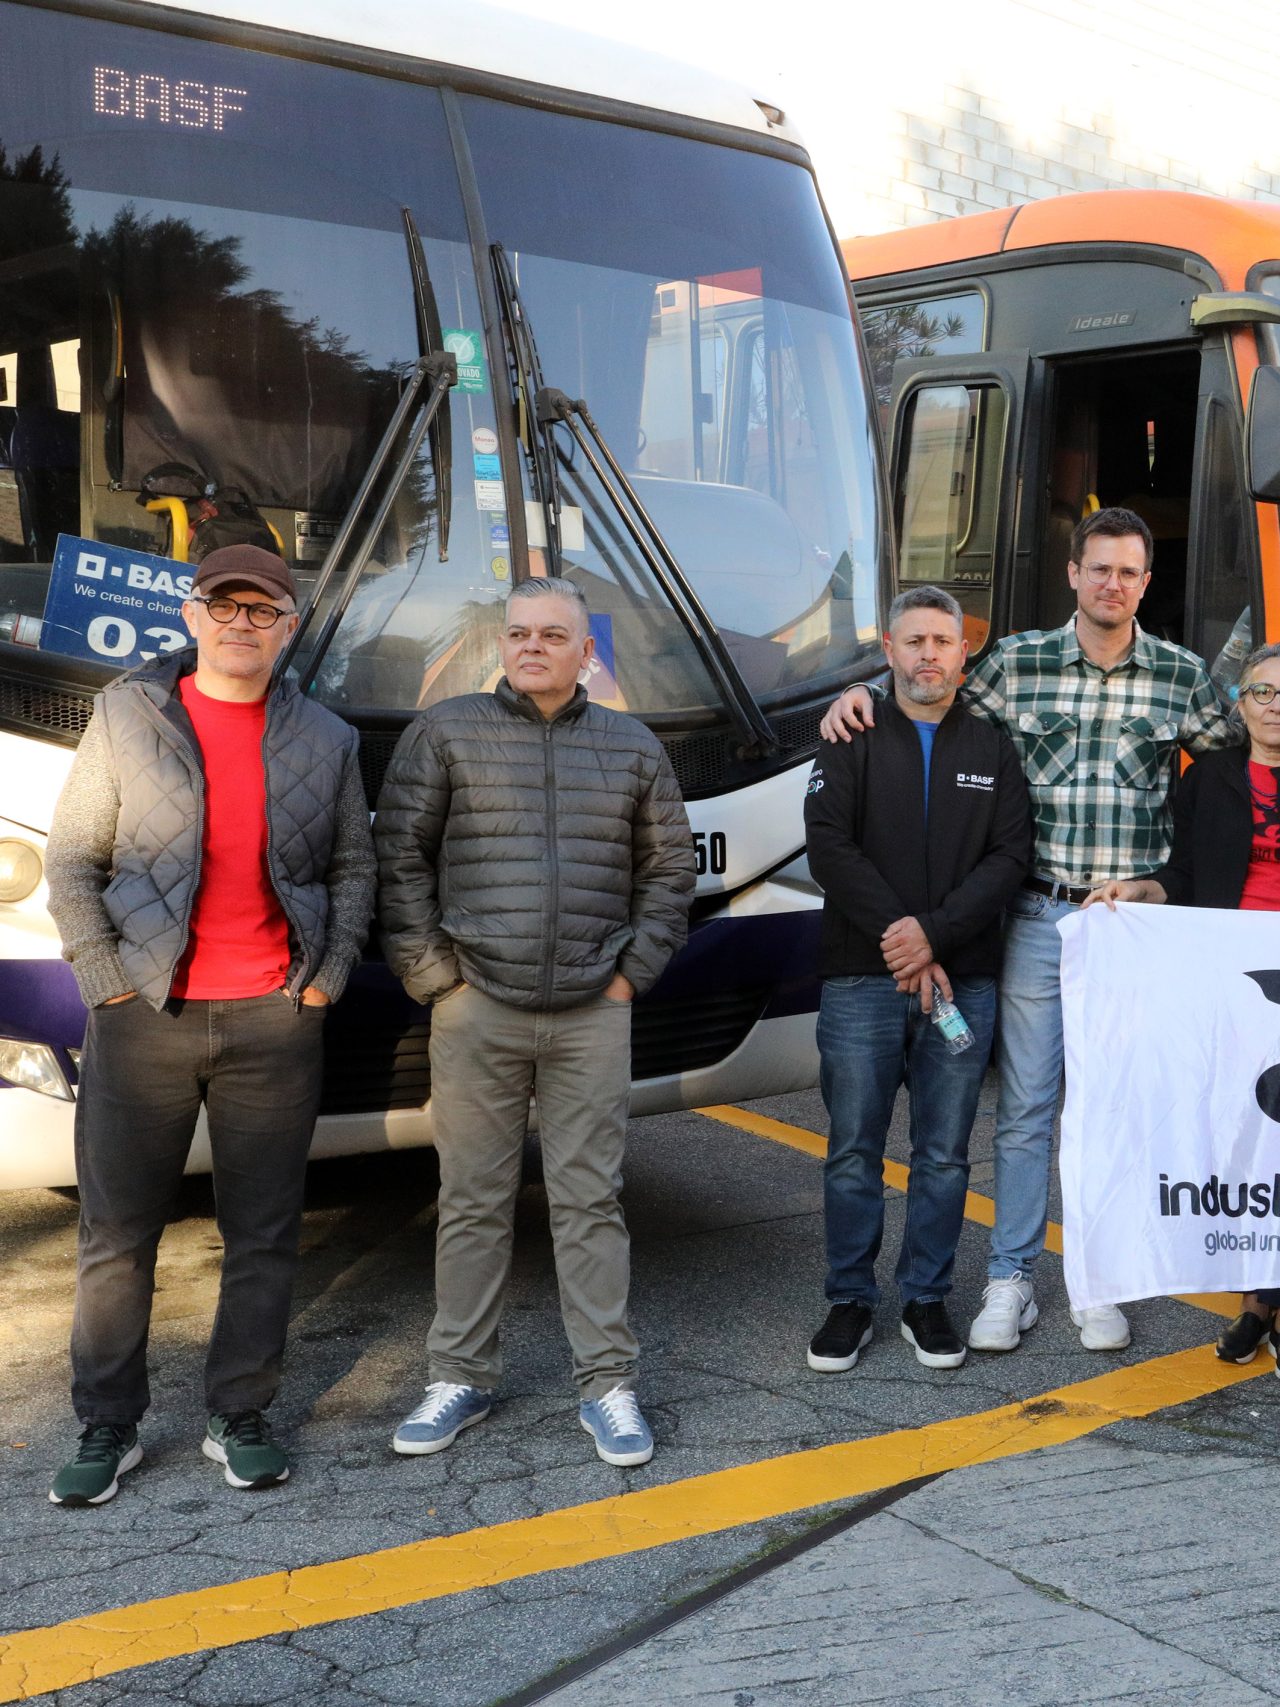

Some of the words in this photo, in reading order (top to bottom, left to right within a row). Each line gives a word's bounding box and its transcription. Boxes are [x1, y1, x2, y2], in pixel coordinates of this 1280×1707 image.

[95, 67, 247, 130] BASF
[1075, 313, 1129, 329] Ideale
[457, 368, 480, 377] OVADO
[127, 564, 193, 600] BAS
[74, 583, 96, 598] We
[99, 591, 143, 608] create
[147, 601, 183, 617] chem
[87, 616, 188, 661] 03
[970, 774, 995, 785] BASF
[692, 832, 727, 876] 50
[1204, 1230, 1257, 1256] global
